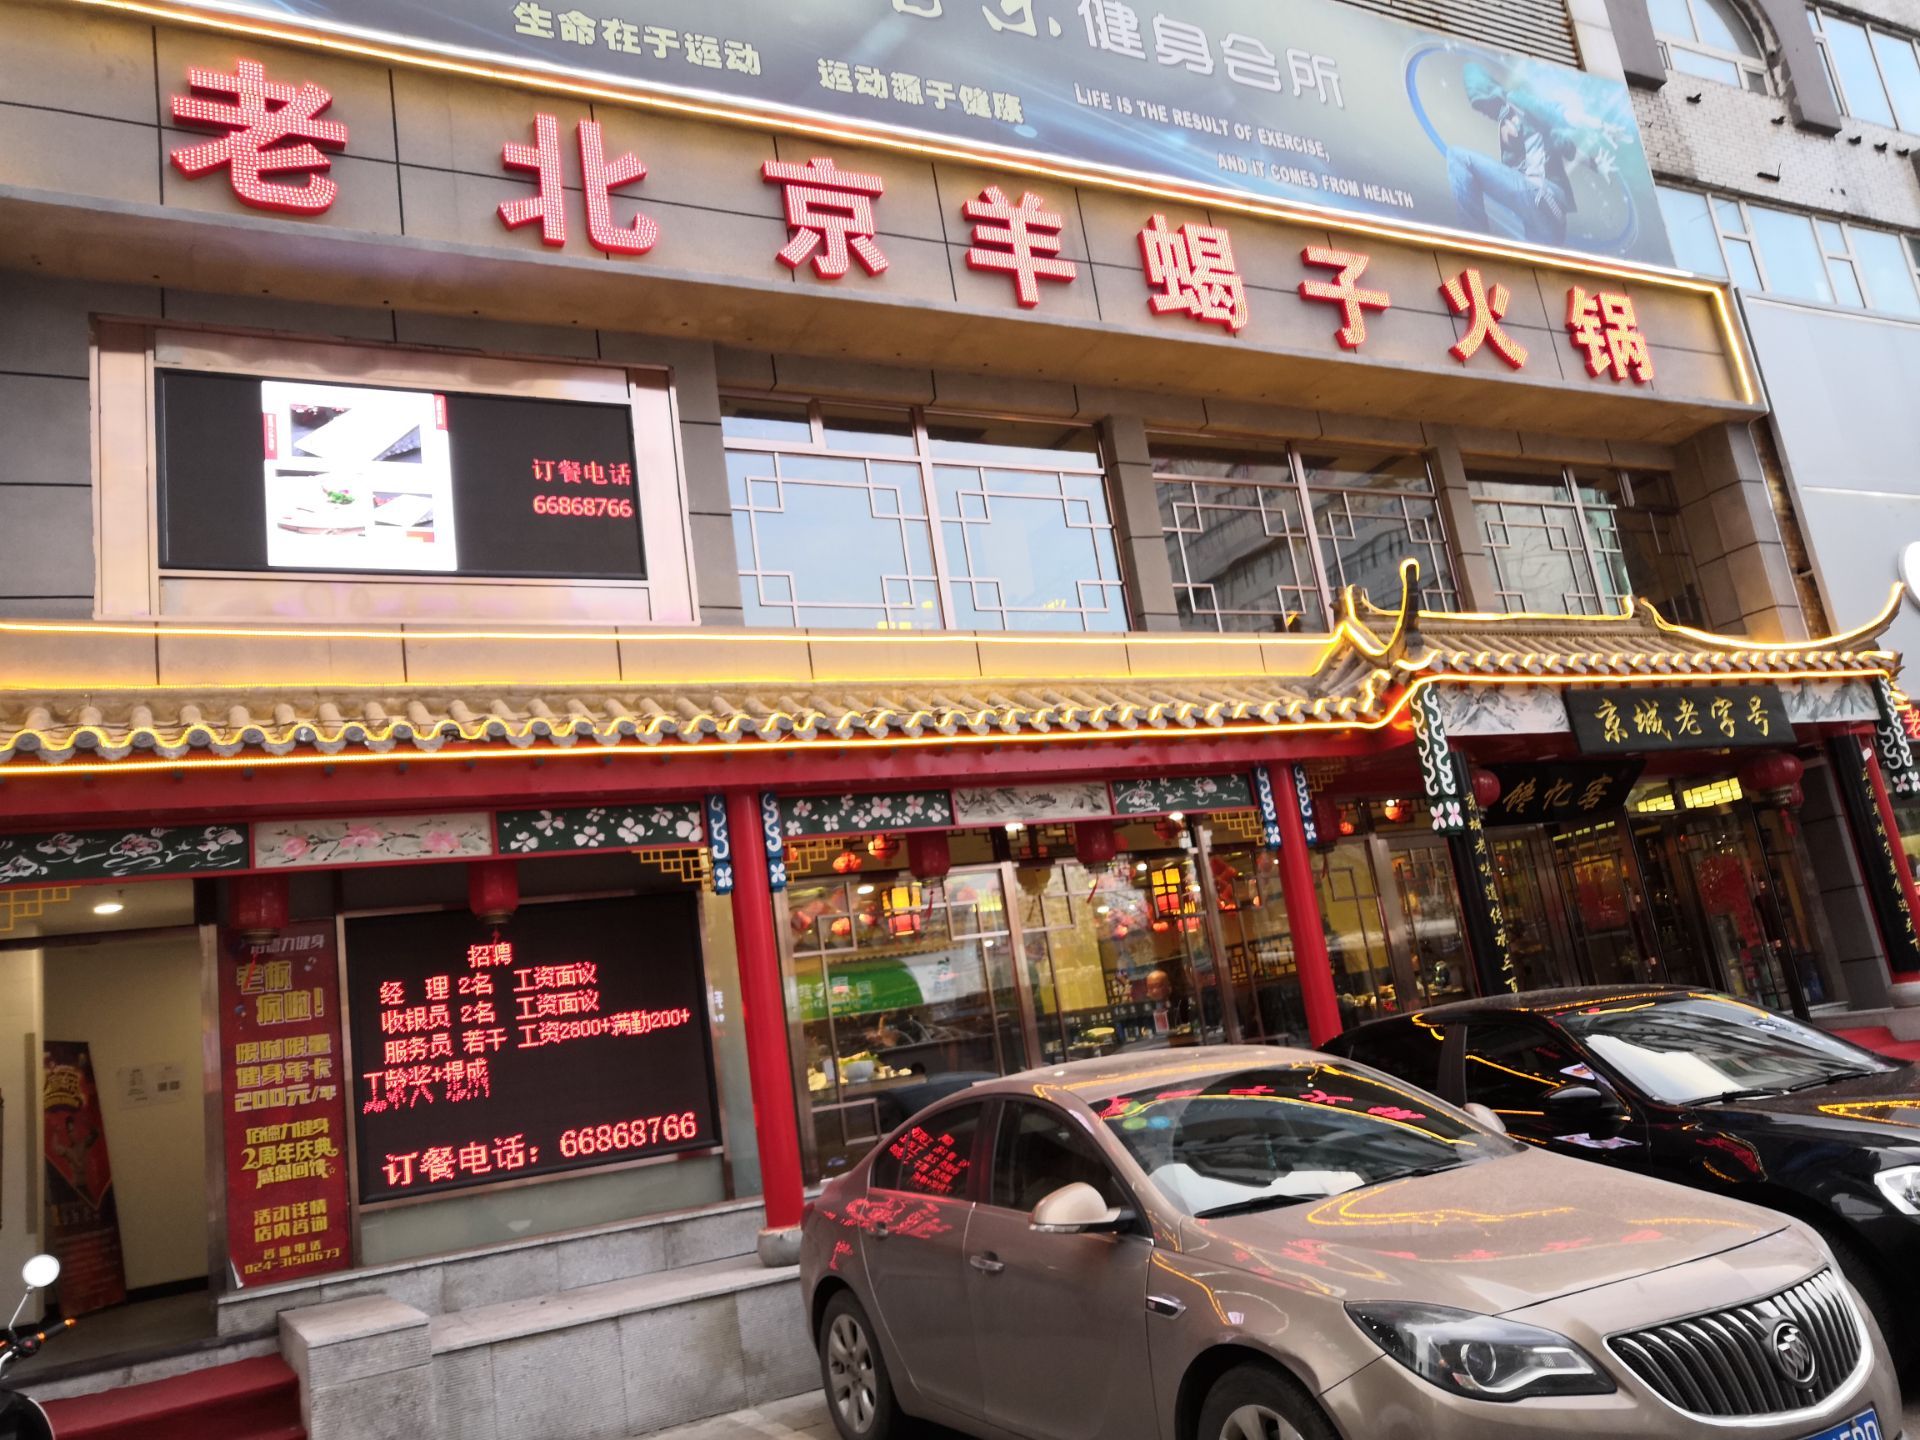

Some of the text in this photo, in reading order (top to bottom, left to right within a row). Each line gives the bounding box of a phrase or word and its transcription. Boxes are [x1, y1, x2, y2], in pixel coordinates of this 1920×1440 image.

[513, 2, 761, 75] 生命在于运动
[1077, 0, 1343, 108] 健身会所
[1074, 82, 1330, 163] LIFE IS THE RESULT OF EXERCISE,
[1218, 153, 1414, 209] AND IT COMES FROM HEALTH
[169, 58, 1655, 384] 老北京羊蝎子火锅
[532, 458, 632, 486] 订餐电话
[533, 494, 633, 518] 66868766
[1594, 694, 1769, 744] 京城老字号
[467, 942, 512, 968] 招聘
[513, 961, 598, 993] 工资面议
[381, 1003, 451, 1034] 收银员
[515, 989, 600, 1021] 工资面议
[383, 1032, 453, 1065] 服务员
[462, 1027, 507, 1054] 若干
[236, 1058, 333, 1089] 健身年卡
[241, 1136, 340, 1170] 2周年庆典
[559, 1111, 697, 1158] 66868766
[256, 1158, 332, 1189] 感恩回馈
[254, 1199, 327, 1226] 活动详情
